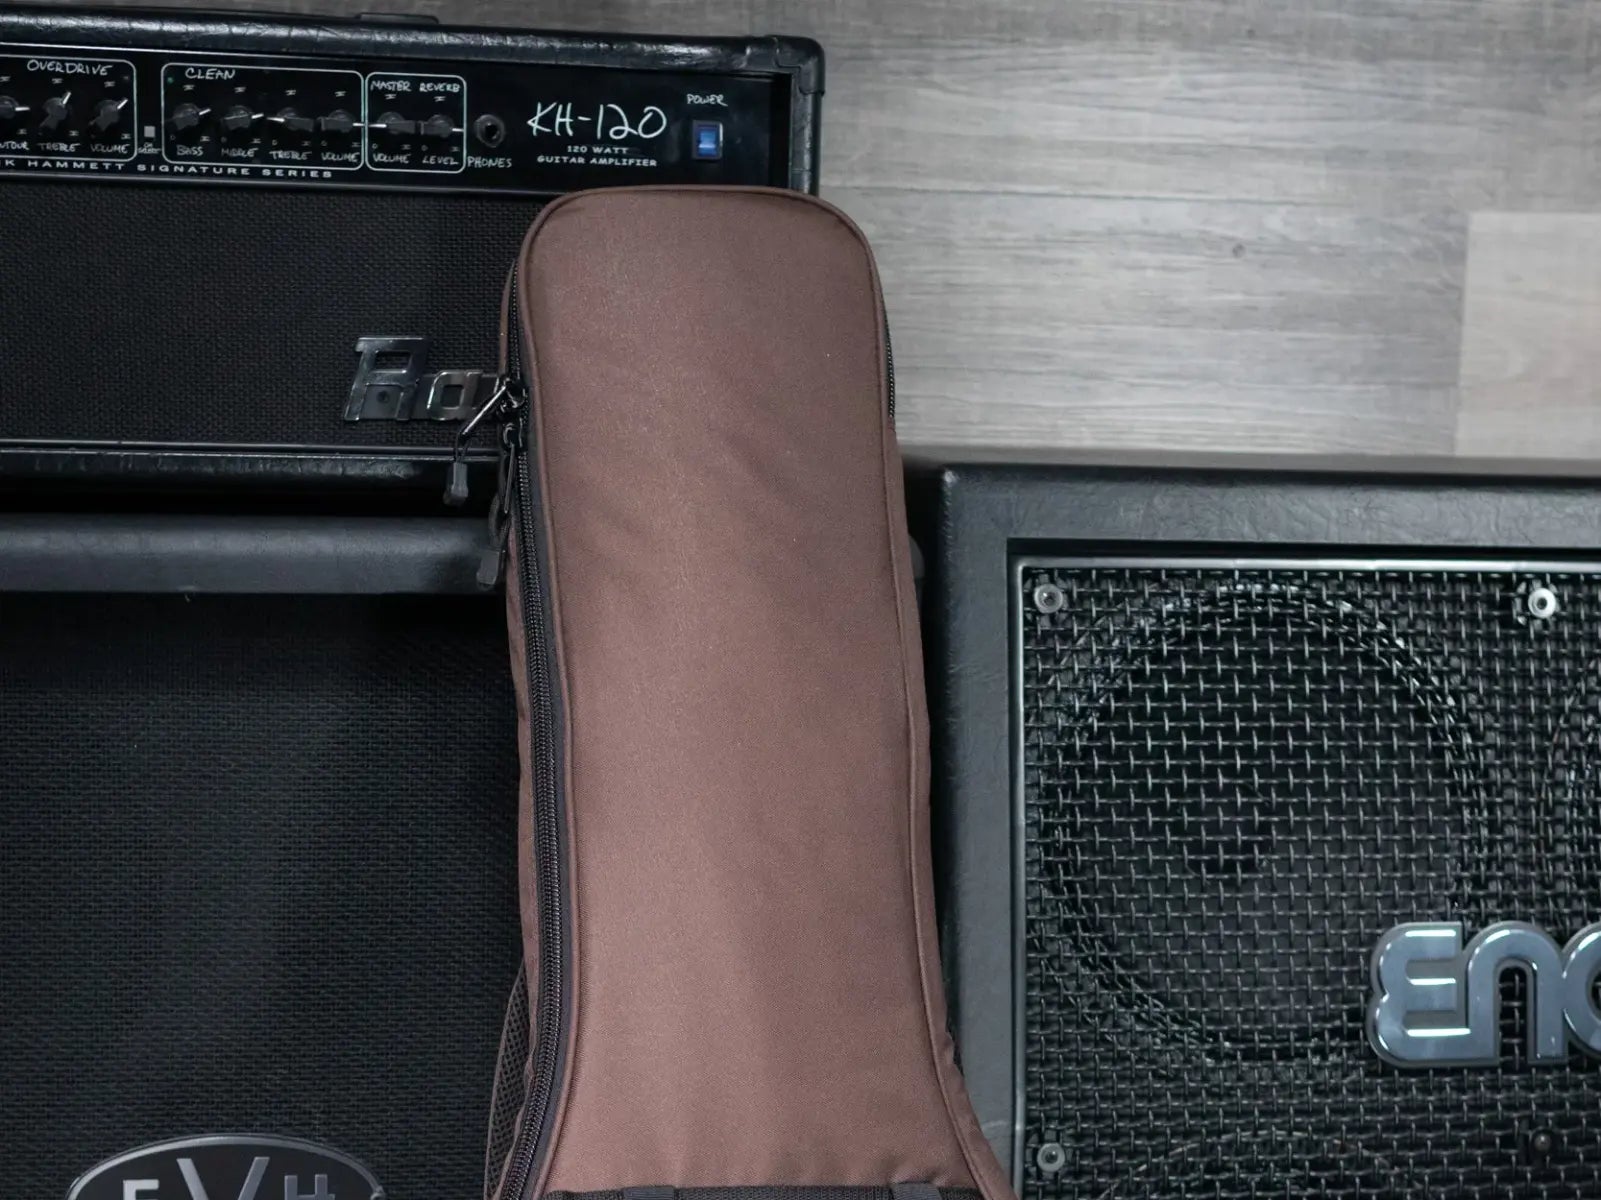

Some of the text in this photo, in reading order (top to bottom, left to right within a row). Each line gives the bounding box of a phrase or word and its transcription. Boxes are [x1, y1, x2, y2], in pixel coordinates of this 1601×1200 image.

[27, 59, 113, 76] OVERDRIVE
[184, 67, 236, 80] CLEAN
[370, 80, 412, 92] MASTER
[419, 82, 461, 93] REVERB
[686, 93, 728, 106] POWER
[527, 102, 667, 140] KH-120
[38, 142, 80, 152] TREBLE
[90, 143, 130, 154] VOLUME
[176, 144, 204, 156] BASS
[221, 147, 259, 158] MIDDLE
[567, 145, 630, 154] 120 WATT
[269, 150, 312, 161] TREBLE
[321, 151, 361, 162] VOLUME
[373, 152, 412, 164] VOLUME
[422, 154, 459, 165] LEVEL
[537, 155, 657, 167] GUITAR AMPLIFIER
[468, 156, 512, 168] PHONES
[28, 160, 125, 170] HAMMETT
[137, 164, 250, 175] SIGNATURE
[262, 169, 332, 178] SERIES
